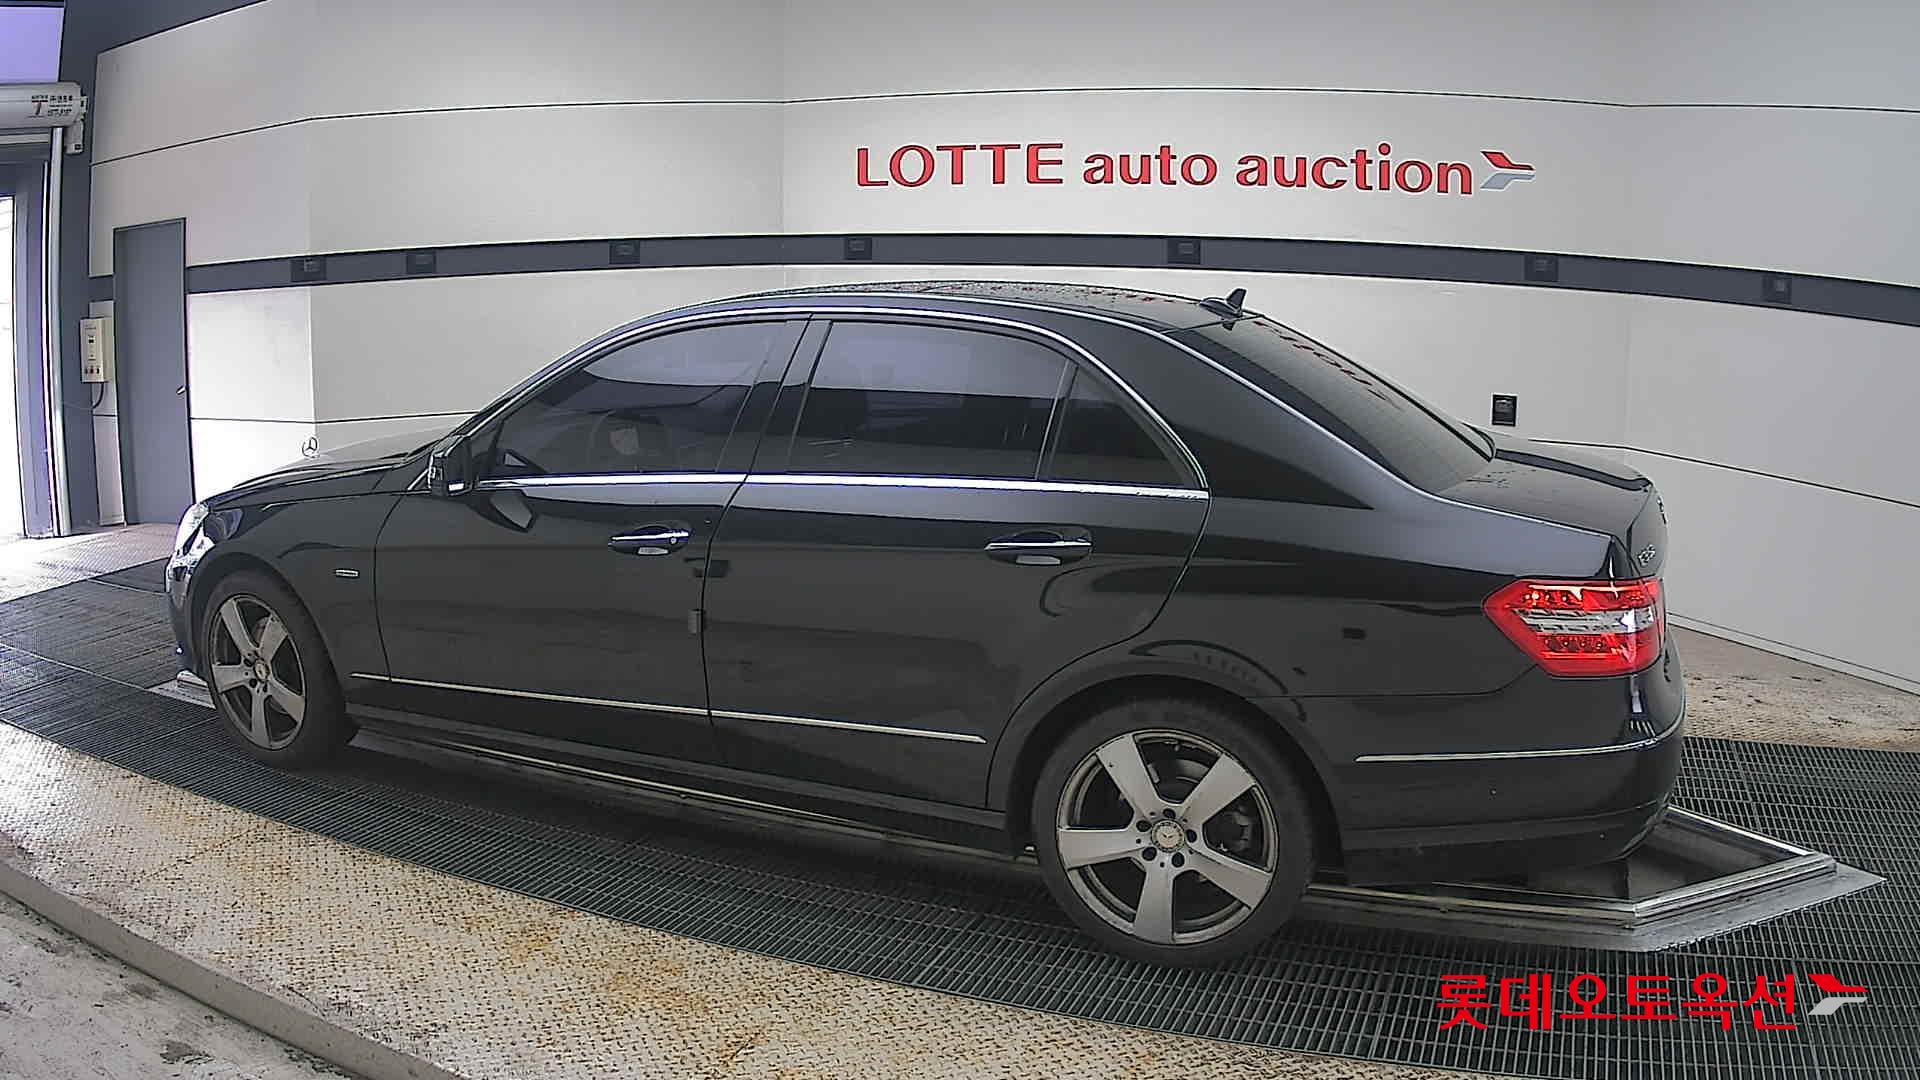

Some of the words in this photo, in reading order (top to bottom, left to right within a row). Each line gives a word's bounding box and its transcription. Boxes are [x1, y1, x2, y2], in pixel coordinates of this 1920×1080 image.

[856, 143, 1064, 187] LOTTE
[1083, 145, 1218, 186] auto
[1235, 142, 1473, 195] auction
